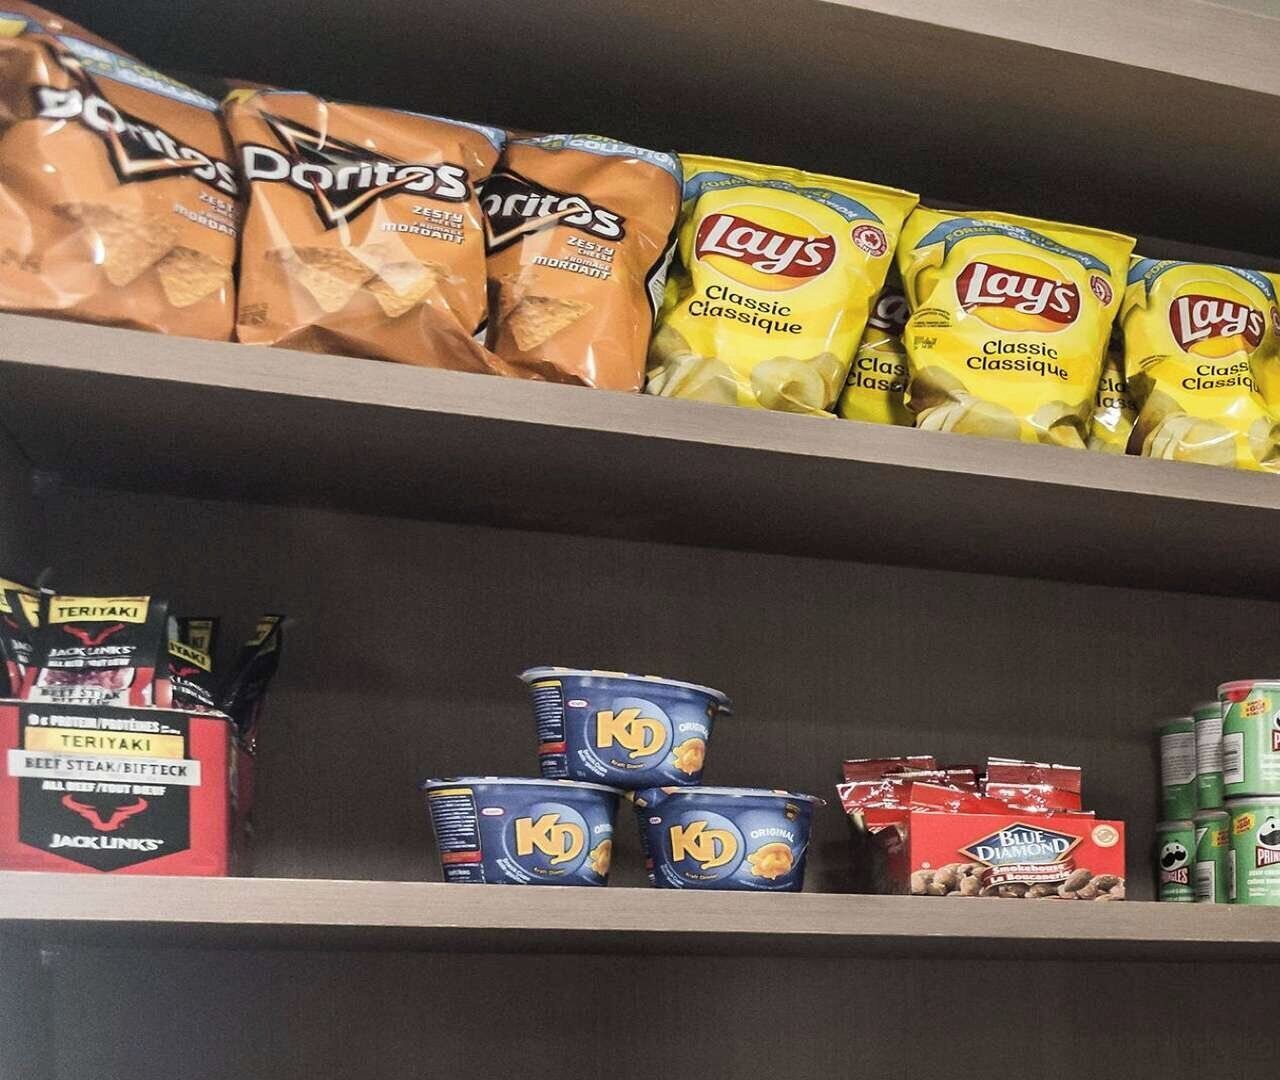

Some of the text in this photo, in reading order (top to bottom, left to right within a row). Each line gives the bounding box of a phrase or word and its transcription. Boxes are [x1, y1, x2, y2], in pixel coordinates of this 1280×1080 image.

[242, 144, 470, 201] Doritos
[411, 204, 464, 222] ZESTY
[427, 216, 464, 230] CHEESE
[380, 223, 465, 244] MORDANT
[566, 235, 615, 257] ZESTY
[577, 246, 613, 262] CHEESE
[700, 215, 831, 275] Lay's
[531, 255, 611, 281] MORDANT
[966, 263, 1075, 315] Lay's
[705, 285, 791, 317] Classic
[688, 301, 803, 335] Classique
[1178, 297, 1265, 345] Lay's
[982, 340, 1058, 361] Classic
[966, 356, 1069, 381] Classique
[57, 606, 138, 619] TERIYAKI
[61, 734, 152, 752] TERIYAKI
[596, 707, 668, 760] KD
[25, 757, 188, 777] BEEF STEAK/BIFTECK
[49, 833, 100, 849] JACK
[514, 812, 584, 865] KD
[669, 820, 738, 870] KD
[750, 829, 794, 843] ORIGINAL
[999, 830, 1047, 848] BLUE
[977, 836, 1071, 863] DIAMOND
[990, 869, 1072, 884] La Boucanerie
[991, 862, 1066, 875] Smokehouse
